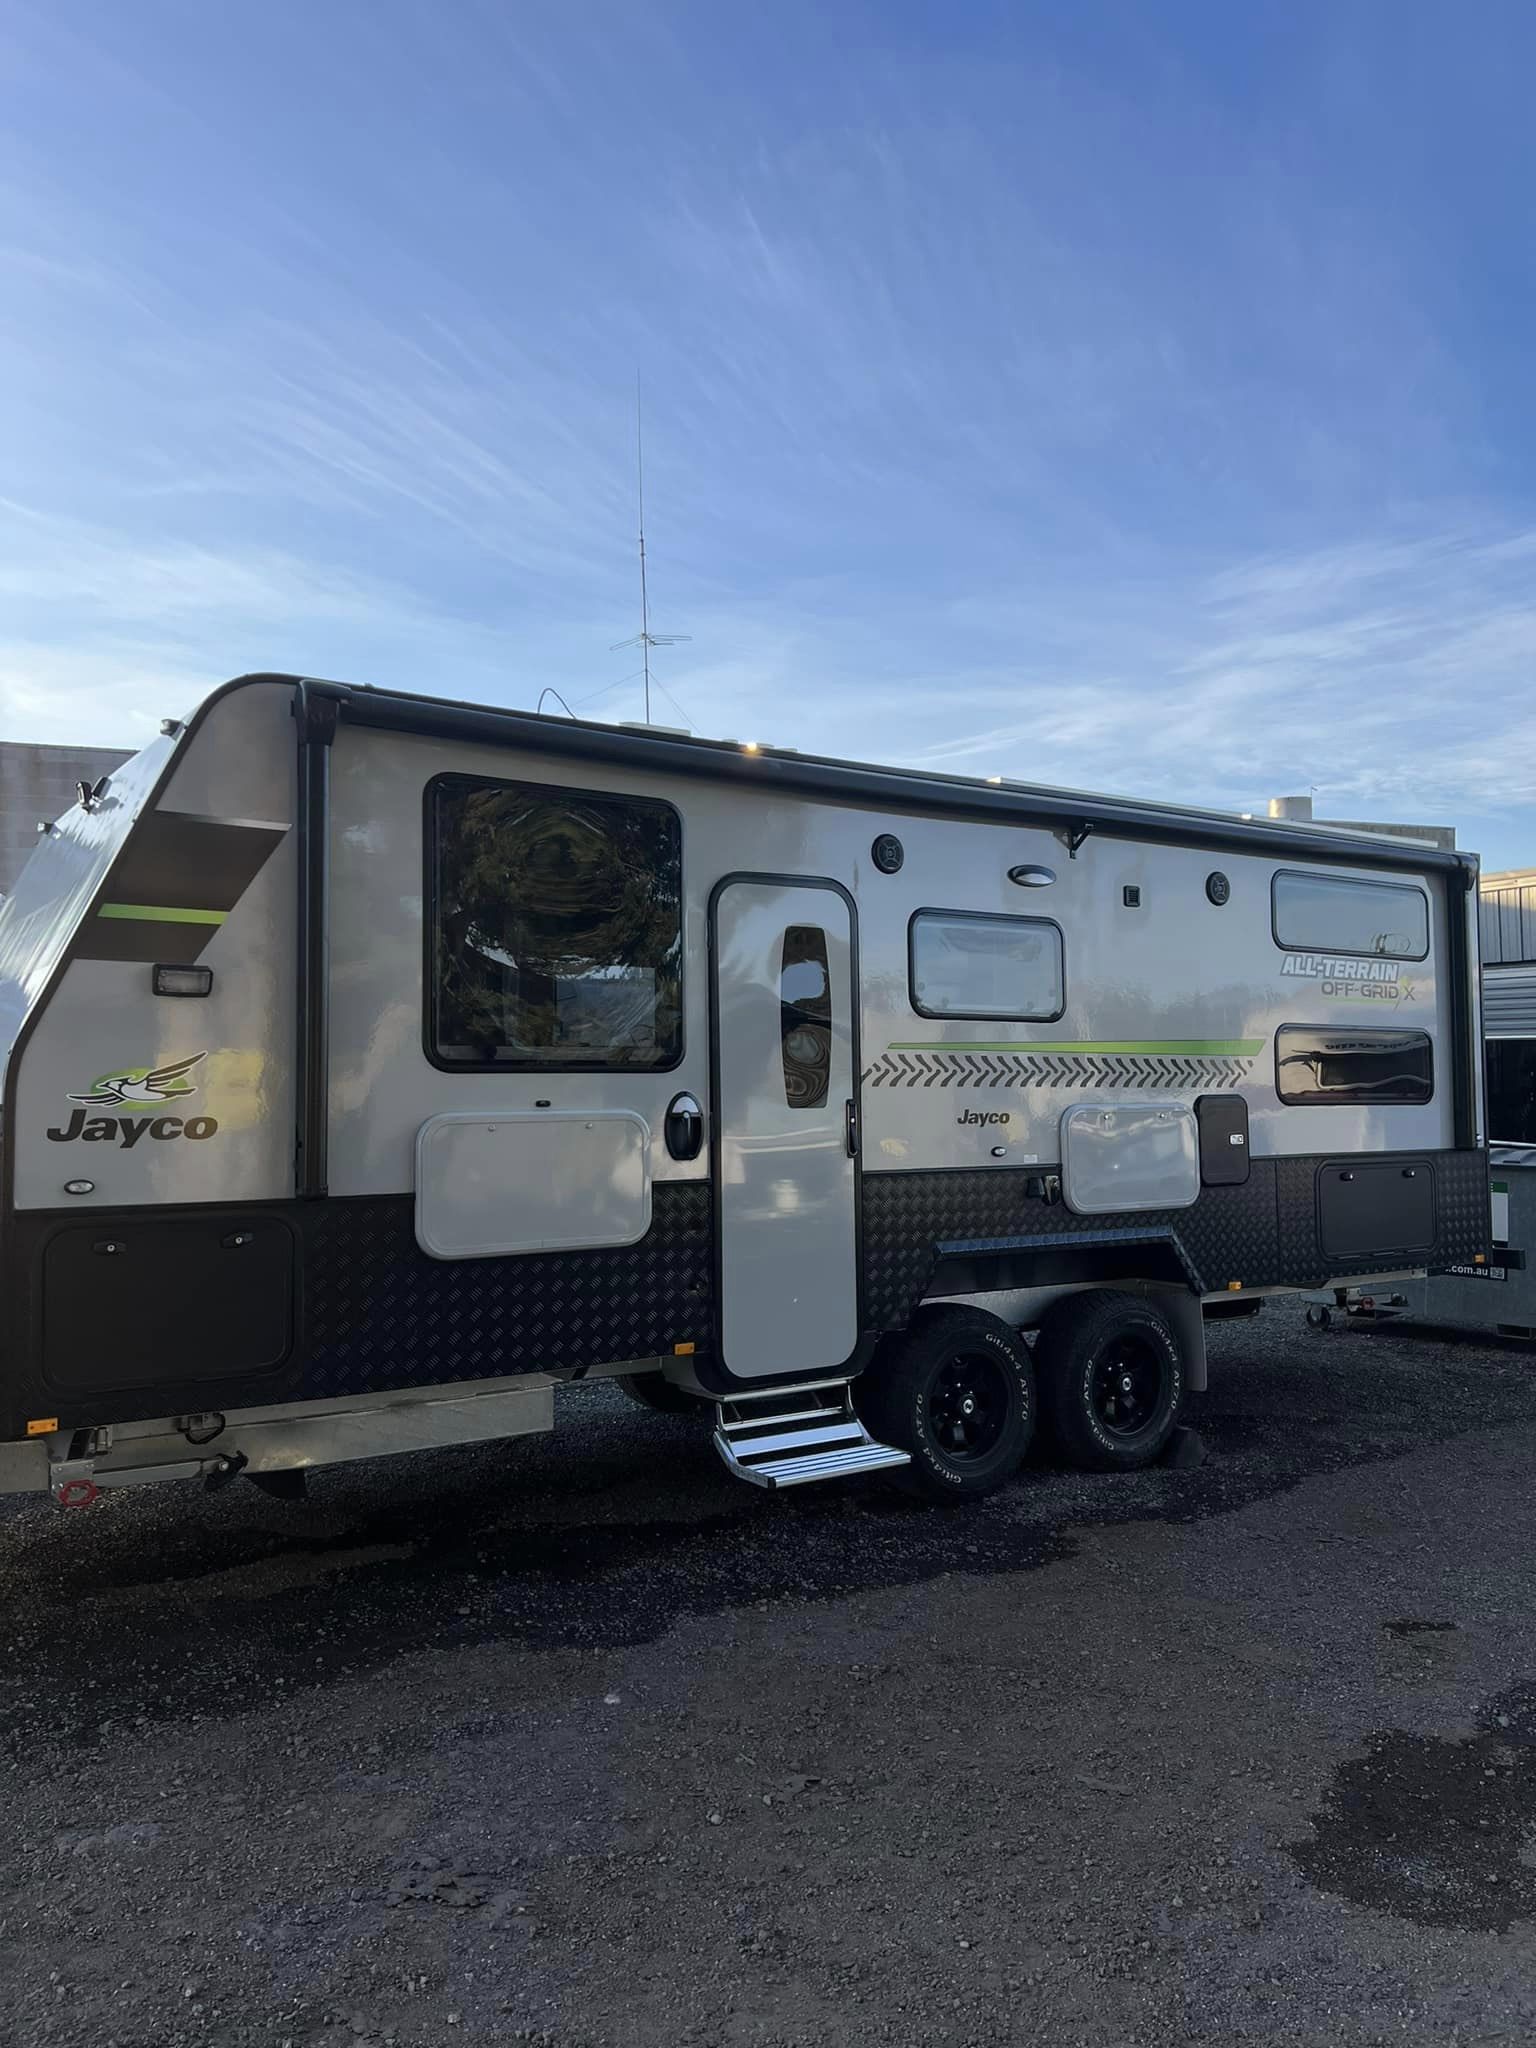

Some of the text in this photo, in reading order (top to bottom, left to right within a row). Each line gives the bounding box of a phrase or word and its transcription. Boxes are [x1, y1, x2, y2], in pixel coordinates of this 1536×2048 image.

[1280, 954, 1399, 984] ALL-TERRAIN
[1321, 981, 1399, 999] OFF-GRID
[957, 1109, 1010, 1128] Jayco
[46, 1109, 218, 1149] Jayco
[1445, 1265, 1489, 1276] .com.au
